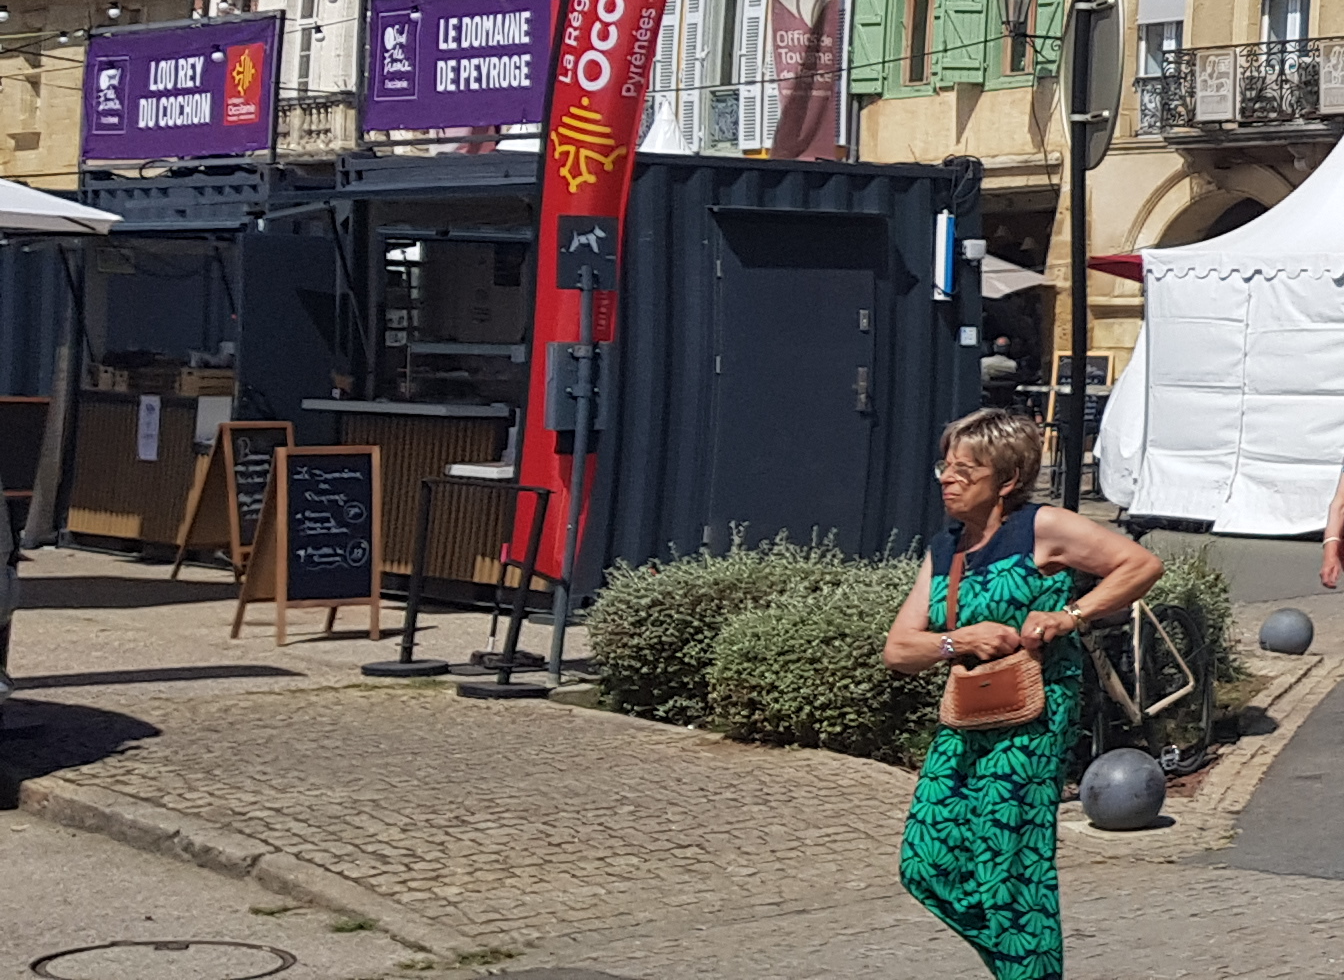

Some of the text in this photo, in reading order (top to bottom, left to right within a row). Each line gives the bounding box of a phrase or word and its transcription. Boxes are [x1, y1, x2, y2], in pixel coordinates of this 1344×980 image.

[438, 11, 531, 50] LE DOMAINE
[558, 54, 575, 83] La
[622, 8, 656, 98] Pyrénées
[149, 58, 175, 91] LOU
[178, 56, 205, 88] REY
[436, 54, 531, 92] DE PEYROGE
[138, 92, 211, 128] DU COCHON
